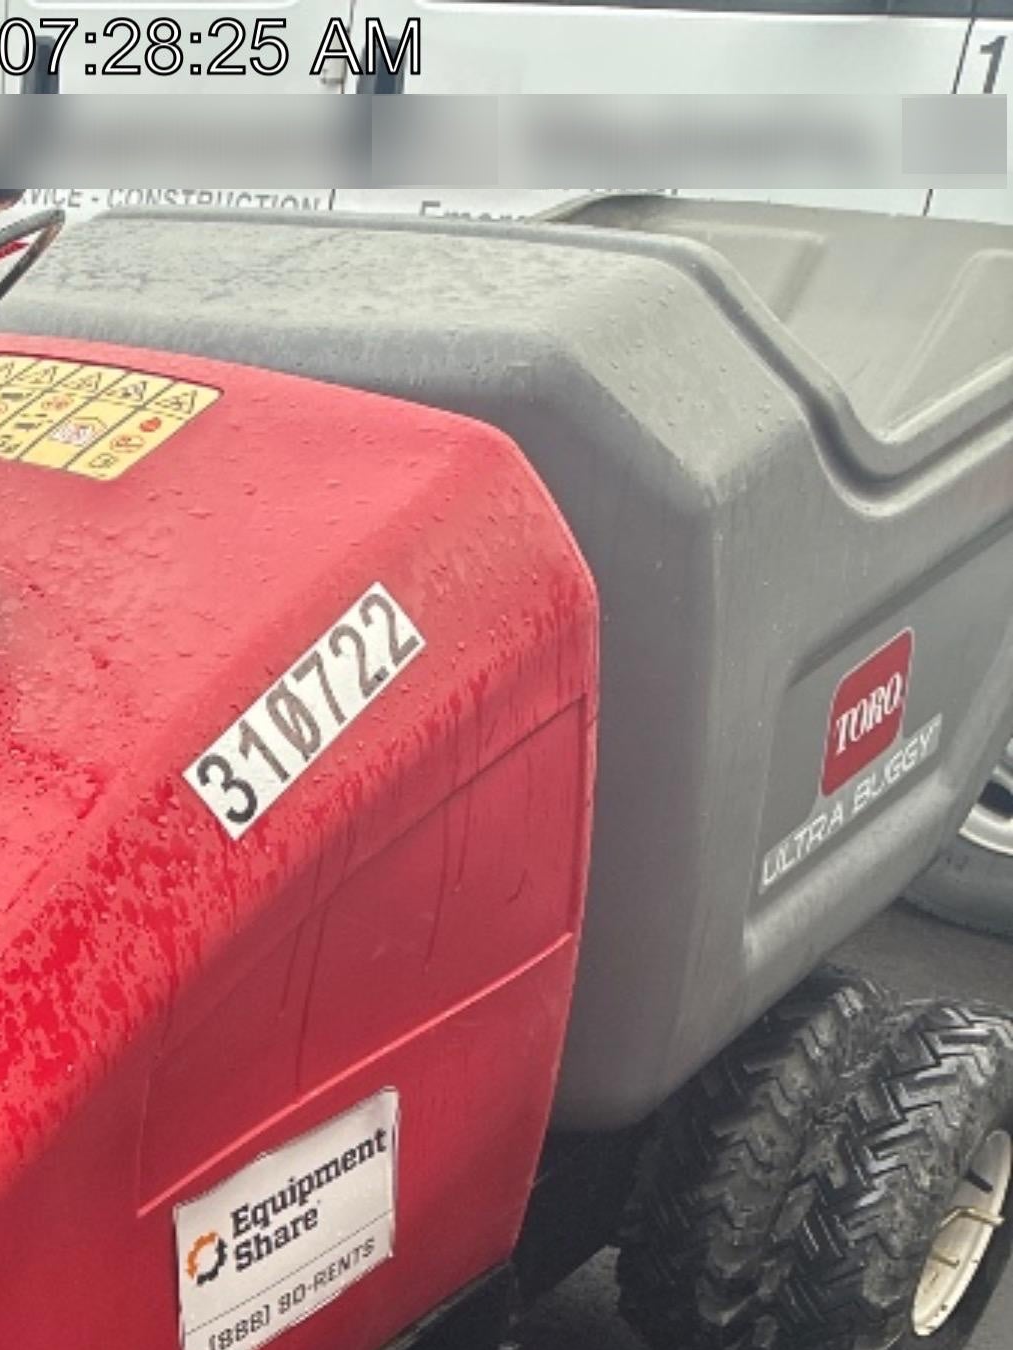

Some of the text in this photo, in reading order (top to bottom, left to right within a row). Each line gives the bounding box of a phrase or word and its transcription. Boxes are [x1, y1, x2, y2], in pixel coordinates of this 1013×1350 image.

[196, 593, 420, 824] 310722
[835, 671, 904, 755] TORO
[761, 722, 933, 887] ULTRA BUGGY
[229, 1127, 388, 1240] Equipment
[234, 1206, 320, 1273] Share
